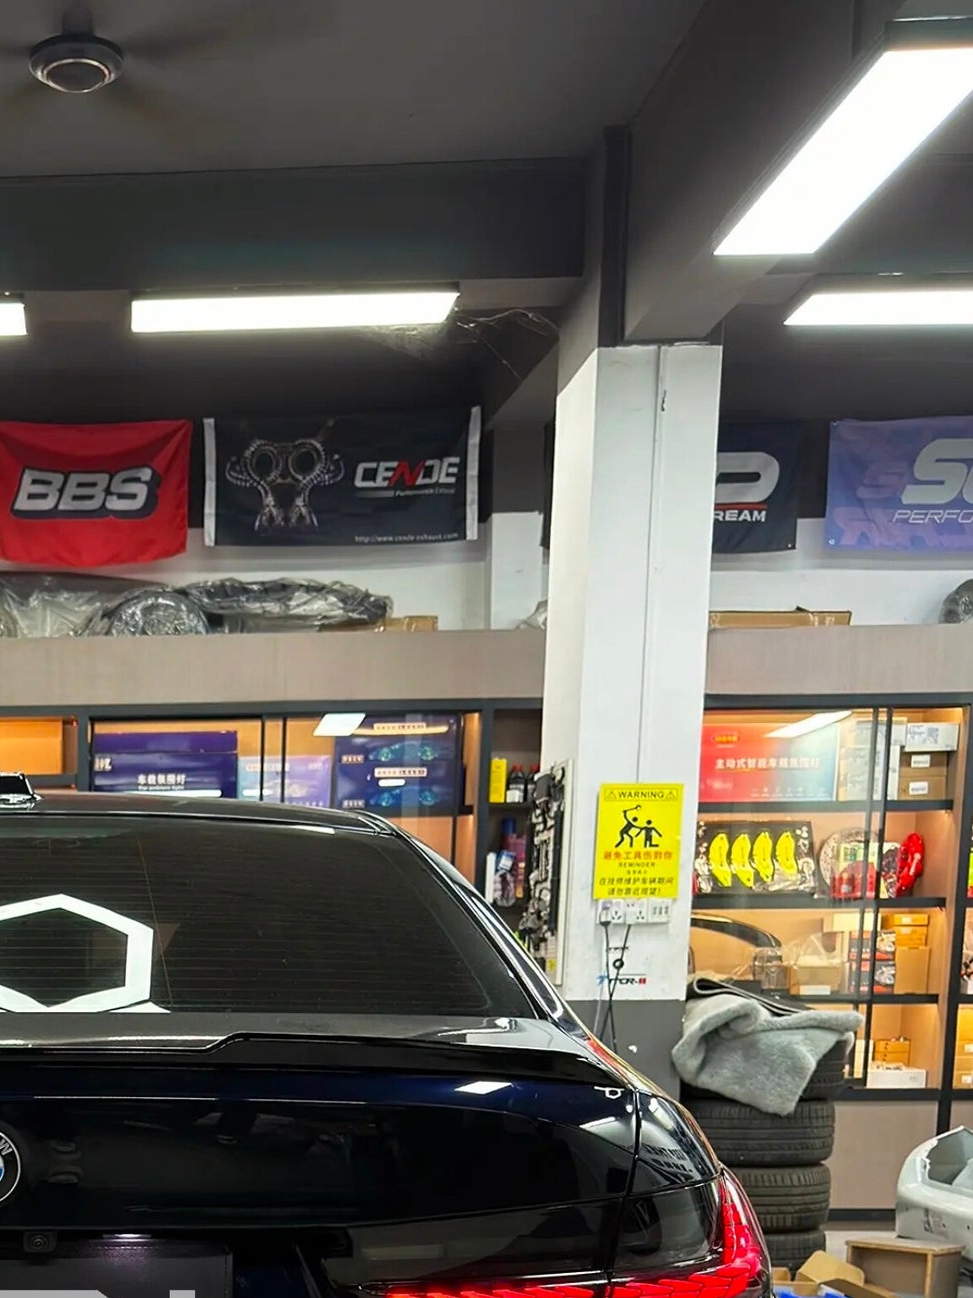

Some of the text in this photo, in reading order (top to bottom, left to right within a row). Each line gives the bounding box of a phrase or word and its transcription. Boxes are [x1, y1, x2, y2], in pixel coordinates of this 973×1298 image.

[12, 466, 155, 512] BBS
[354, 457, 461, 488] CENDE
[901, 438, 973, 505] S
[618, 790, 665, 799] WARNING
